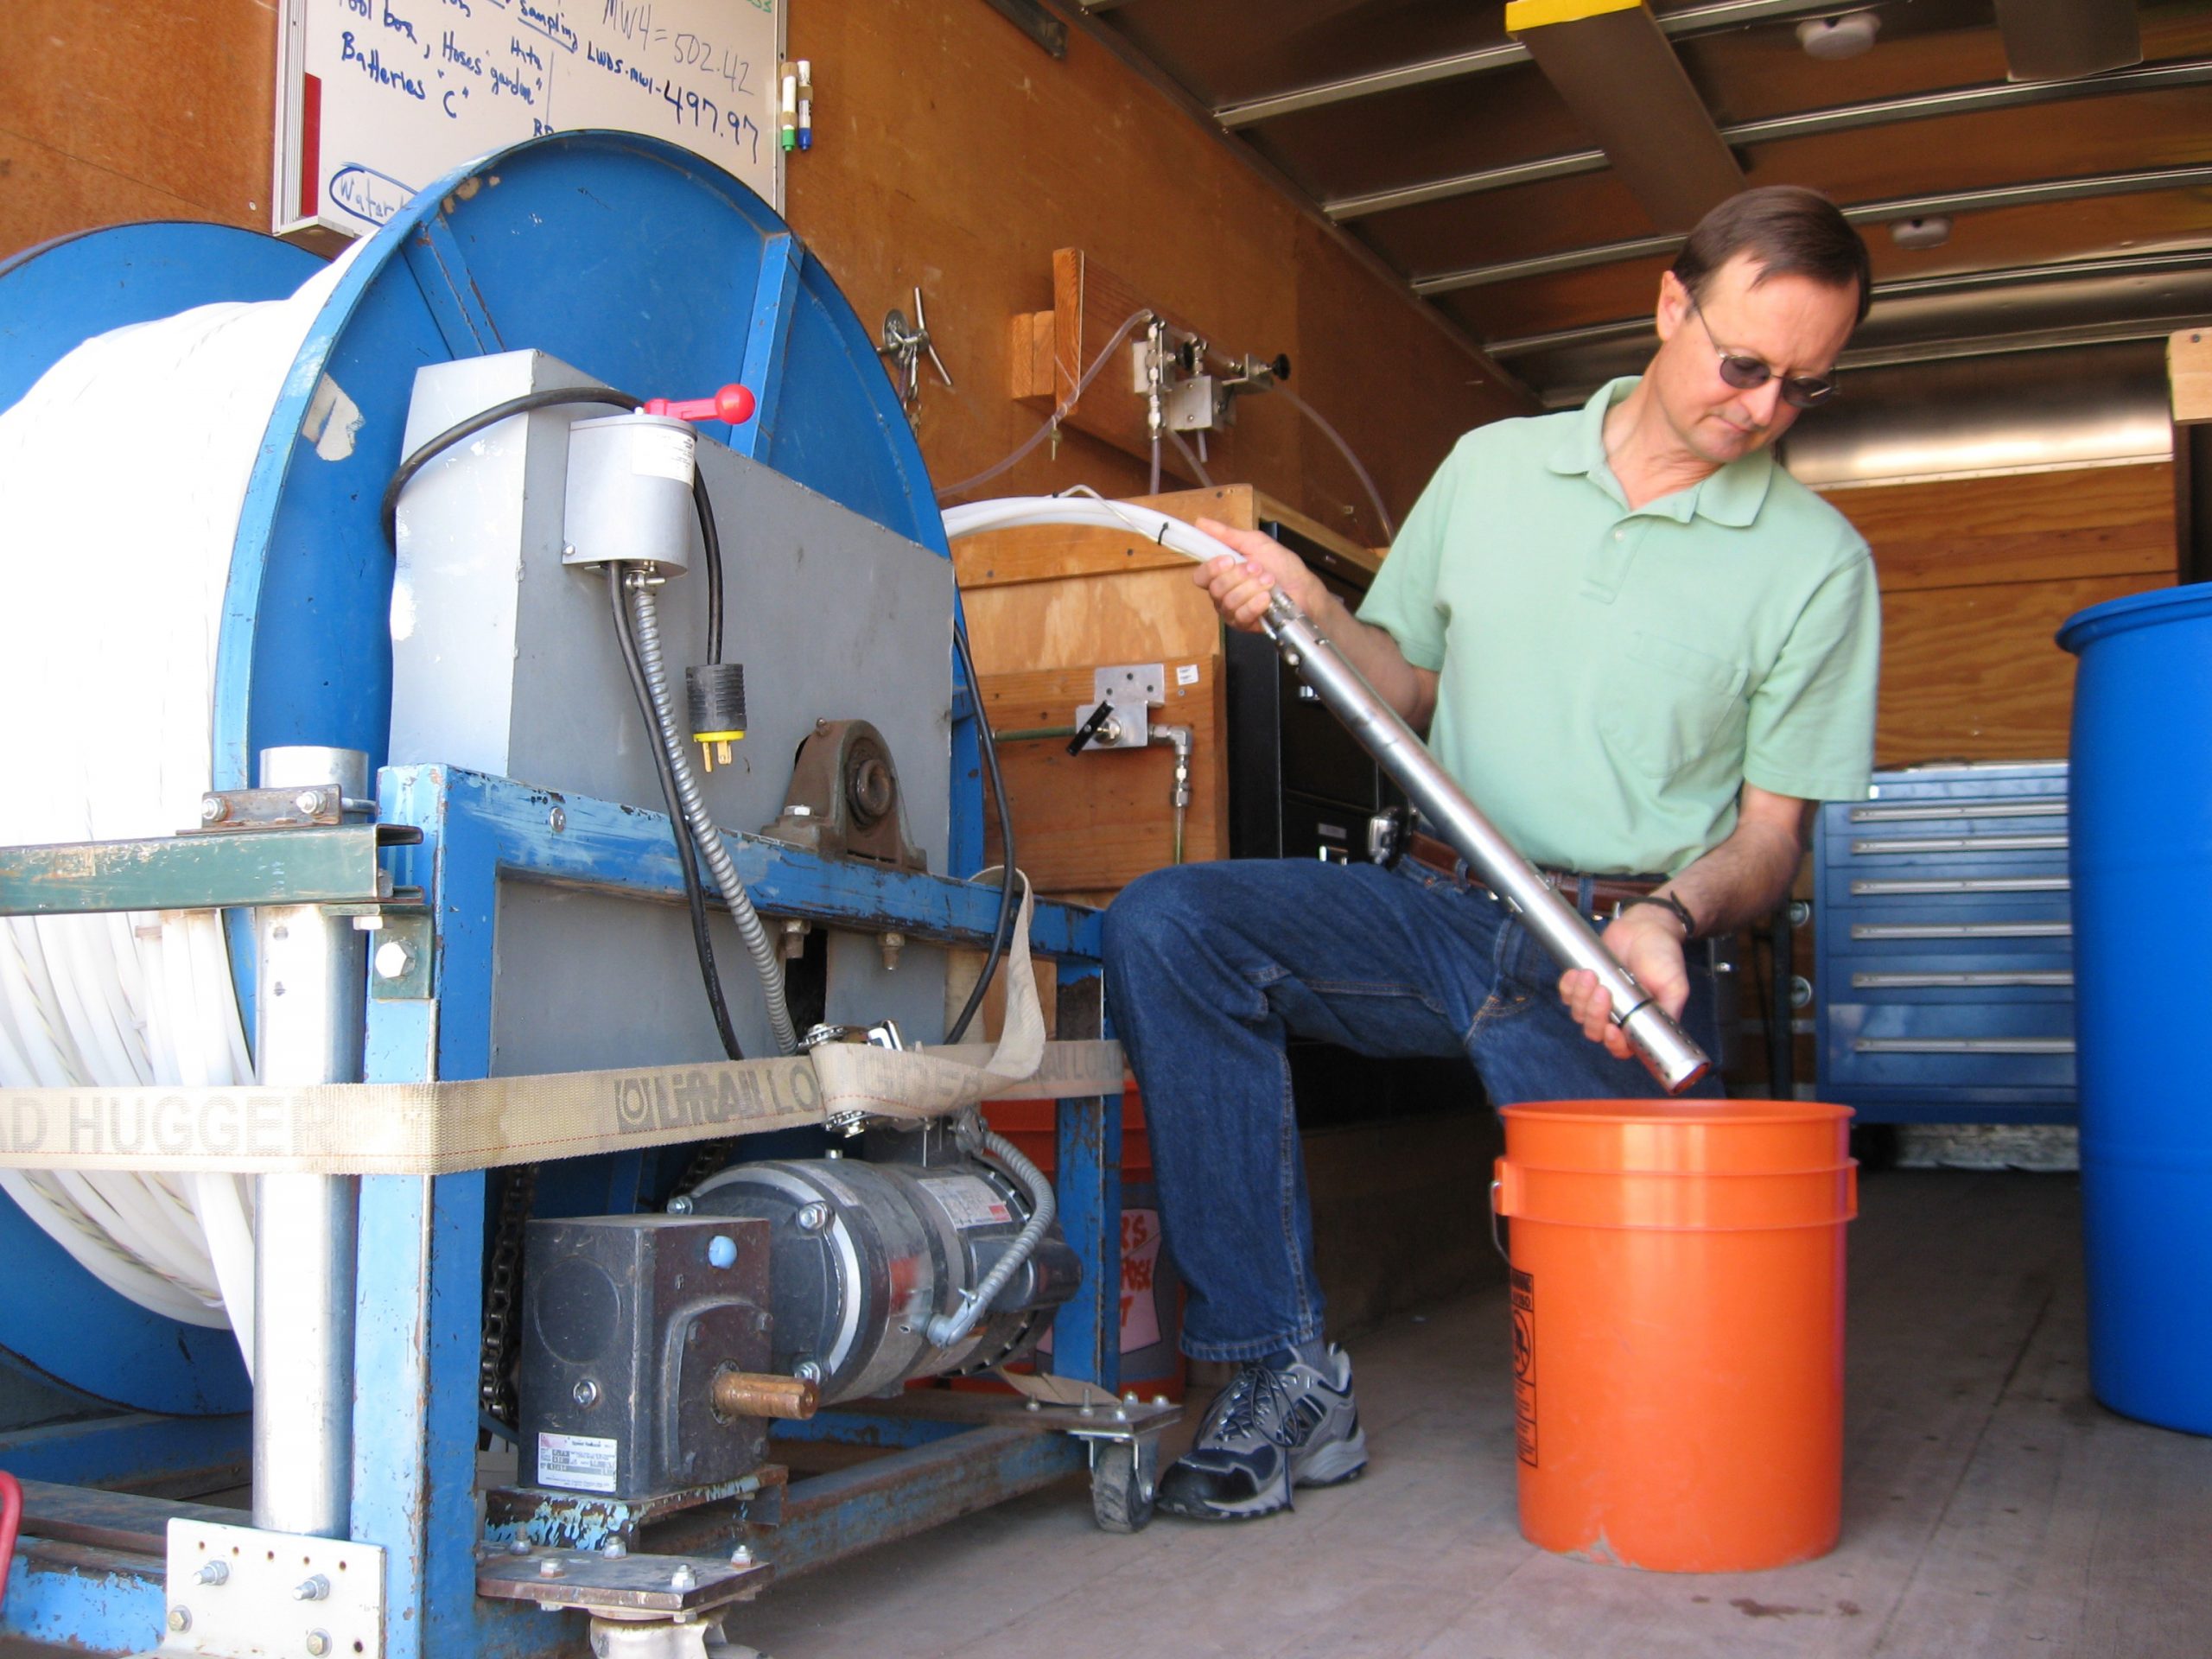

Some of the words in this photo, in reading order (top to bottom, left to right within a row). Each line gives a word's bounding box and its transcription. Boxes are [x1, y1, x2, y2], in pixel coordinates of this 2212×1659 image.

[340, 0, 372, 20] ool
[674, 33, 754, 95] 502.42
[70, 1095, 334, 1157] HUGGER
